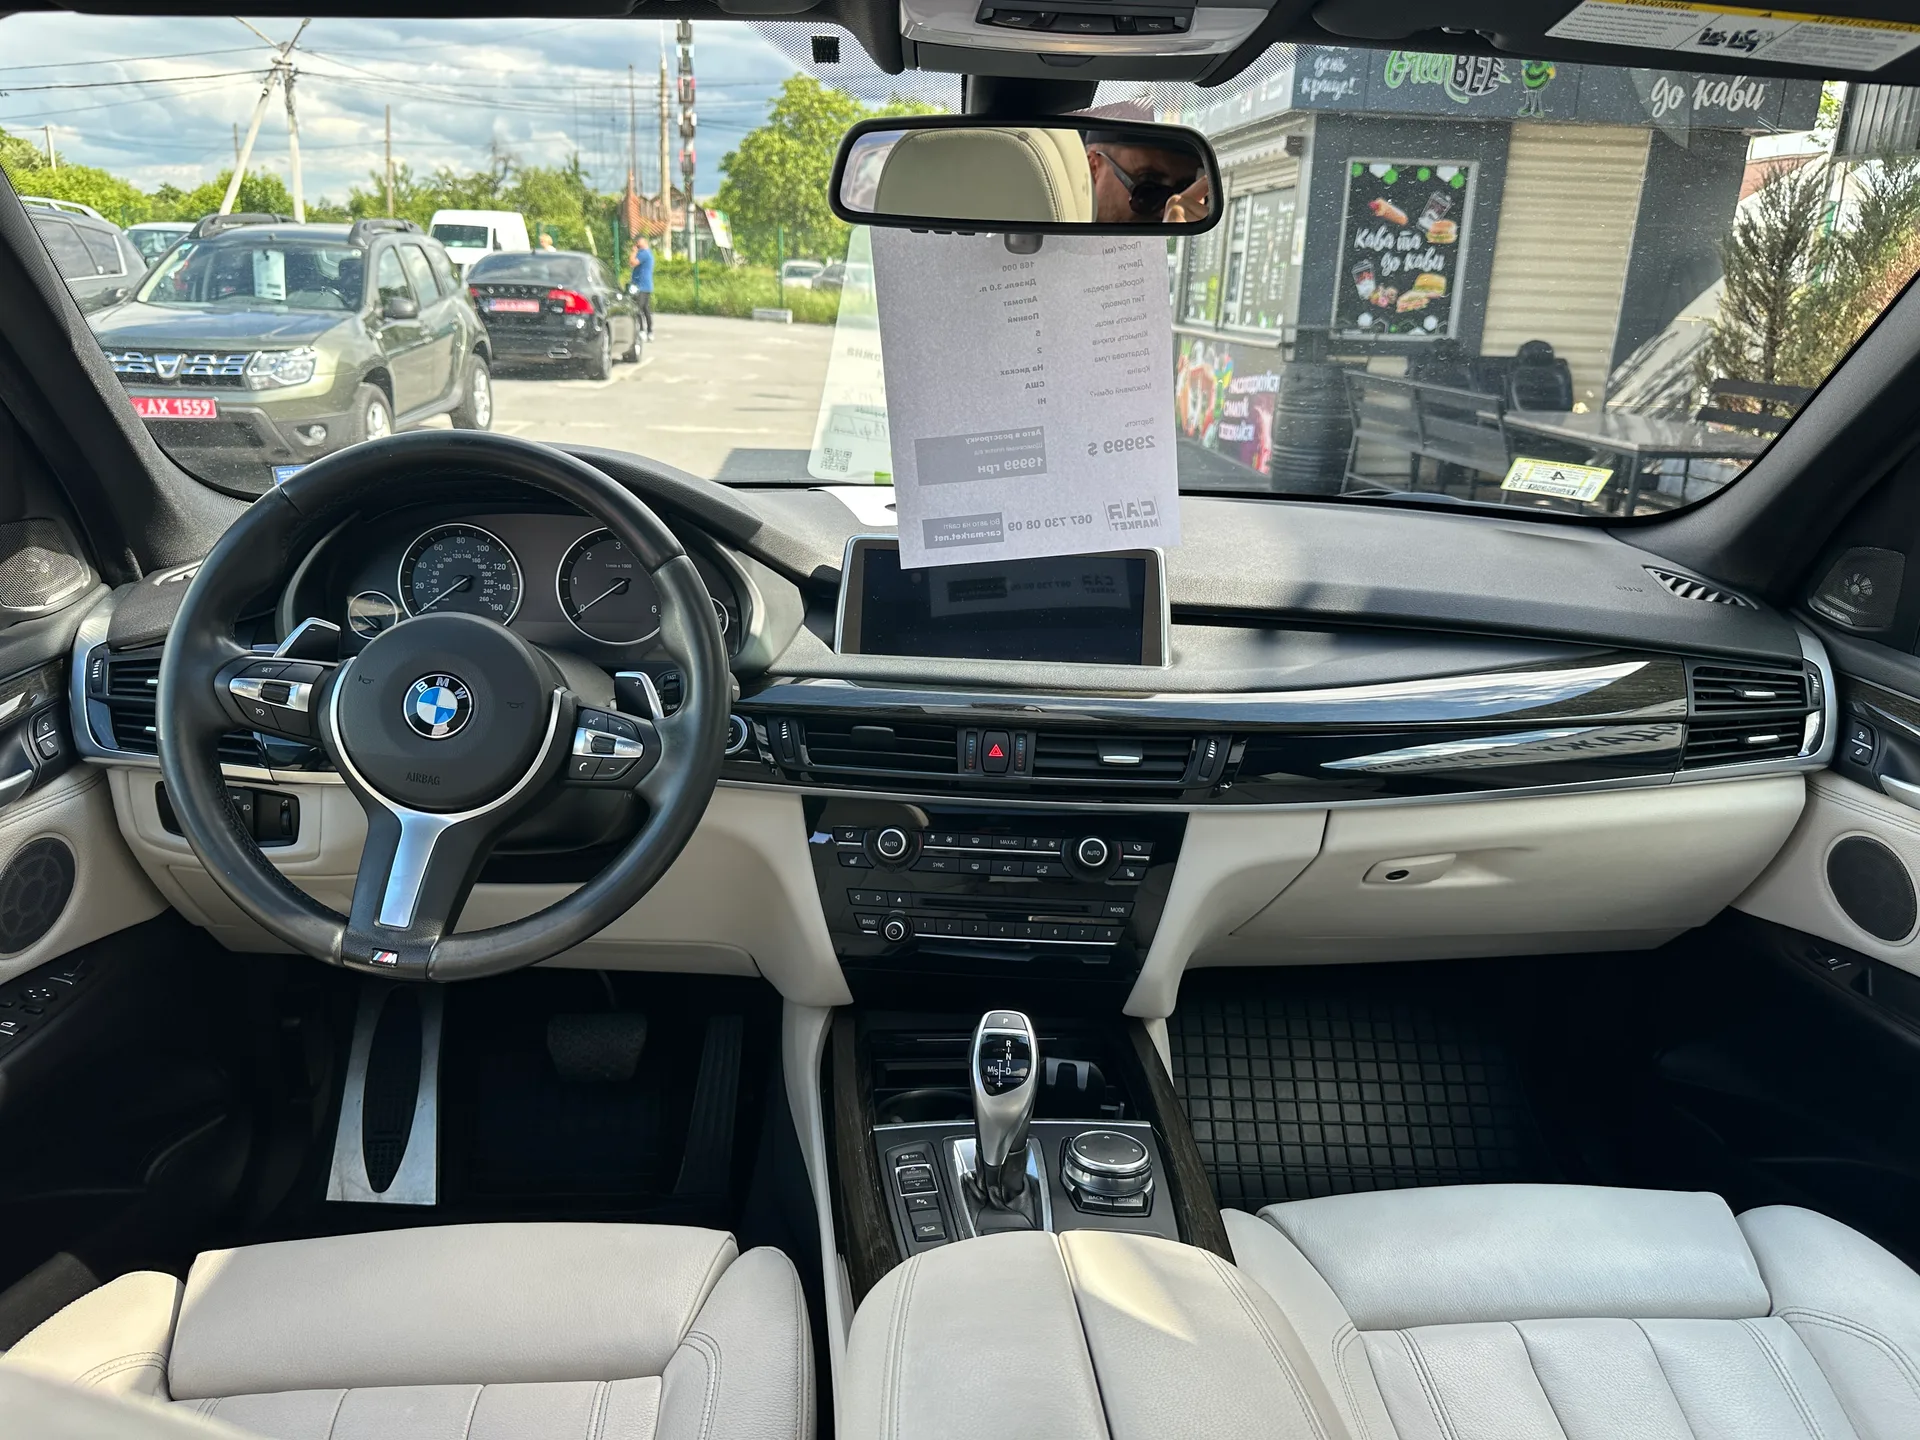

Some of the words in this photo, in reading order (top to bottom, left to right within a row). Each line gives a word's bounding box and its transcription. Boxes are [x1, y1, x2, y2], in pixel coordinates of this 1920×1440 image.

[1625, 0, 1693, 10] WARNING
[1650, 75, 1684, 117] до
[1692, 73, 1766, 112] кави
[1353, 224, 1396, 252] Кава
[1380, 251, 1402, 277] до
[1403, 246, 1446, 272] кави
[147, 399, 169, 414] AX
[173, 399, 211, 414] 1559
[456, 537, 466, 545] 80
[615, 541, 621, 550] 3
[433, 544, 444, 552] 60
[476, 544, 490, 553] 100
[586, 552, 592, 561] 2
[417, 561, 427, 570] 40
[493, 562, 507, 571] 120
[573, 576, 578, 585] 1
[415, 581, 425, 590] 20
[497, 583, 511, 592] 140
[490, 603, 504, 612] 160
[651, 604, 657, 614] 6
[415, 675, 468, 701] BMW
[405, 771, 441, 786] AIRBAG
[884, 840, 898, 848] AUTO
[1110, 906, 1125, 914] MODE
[1005, 1053, 1012, 1061] N
[987, 1065, 999, 1076] M/S
[1005, 1067, 1012, 1075] D
